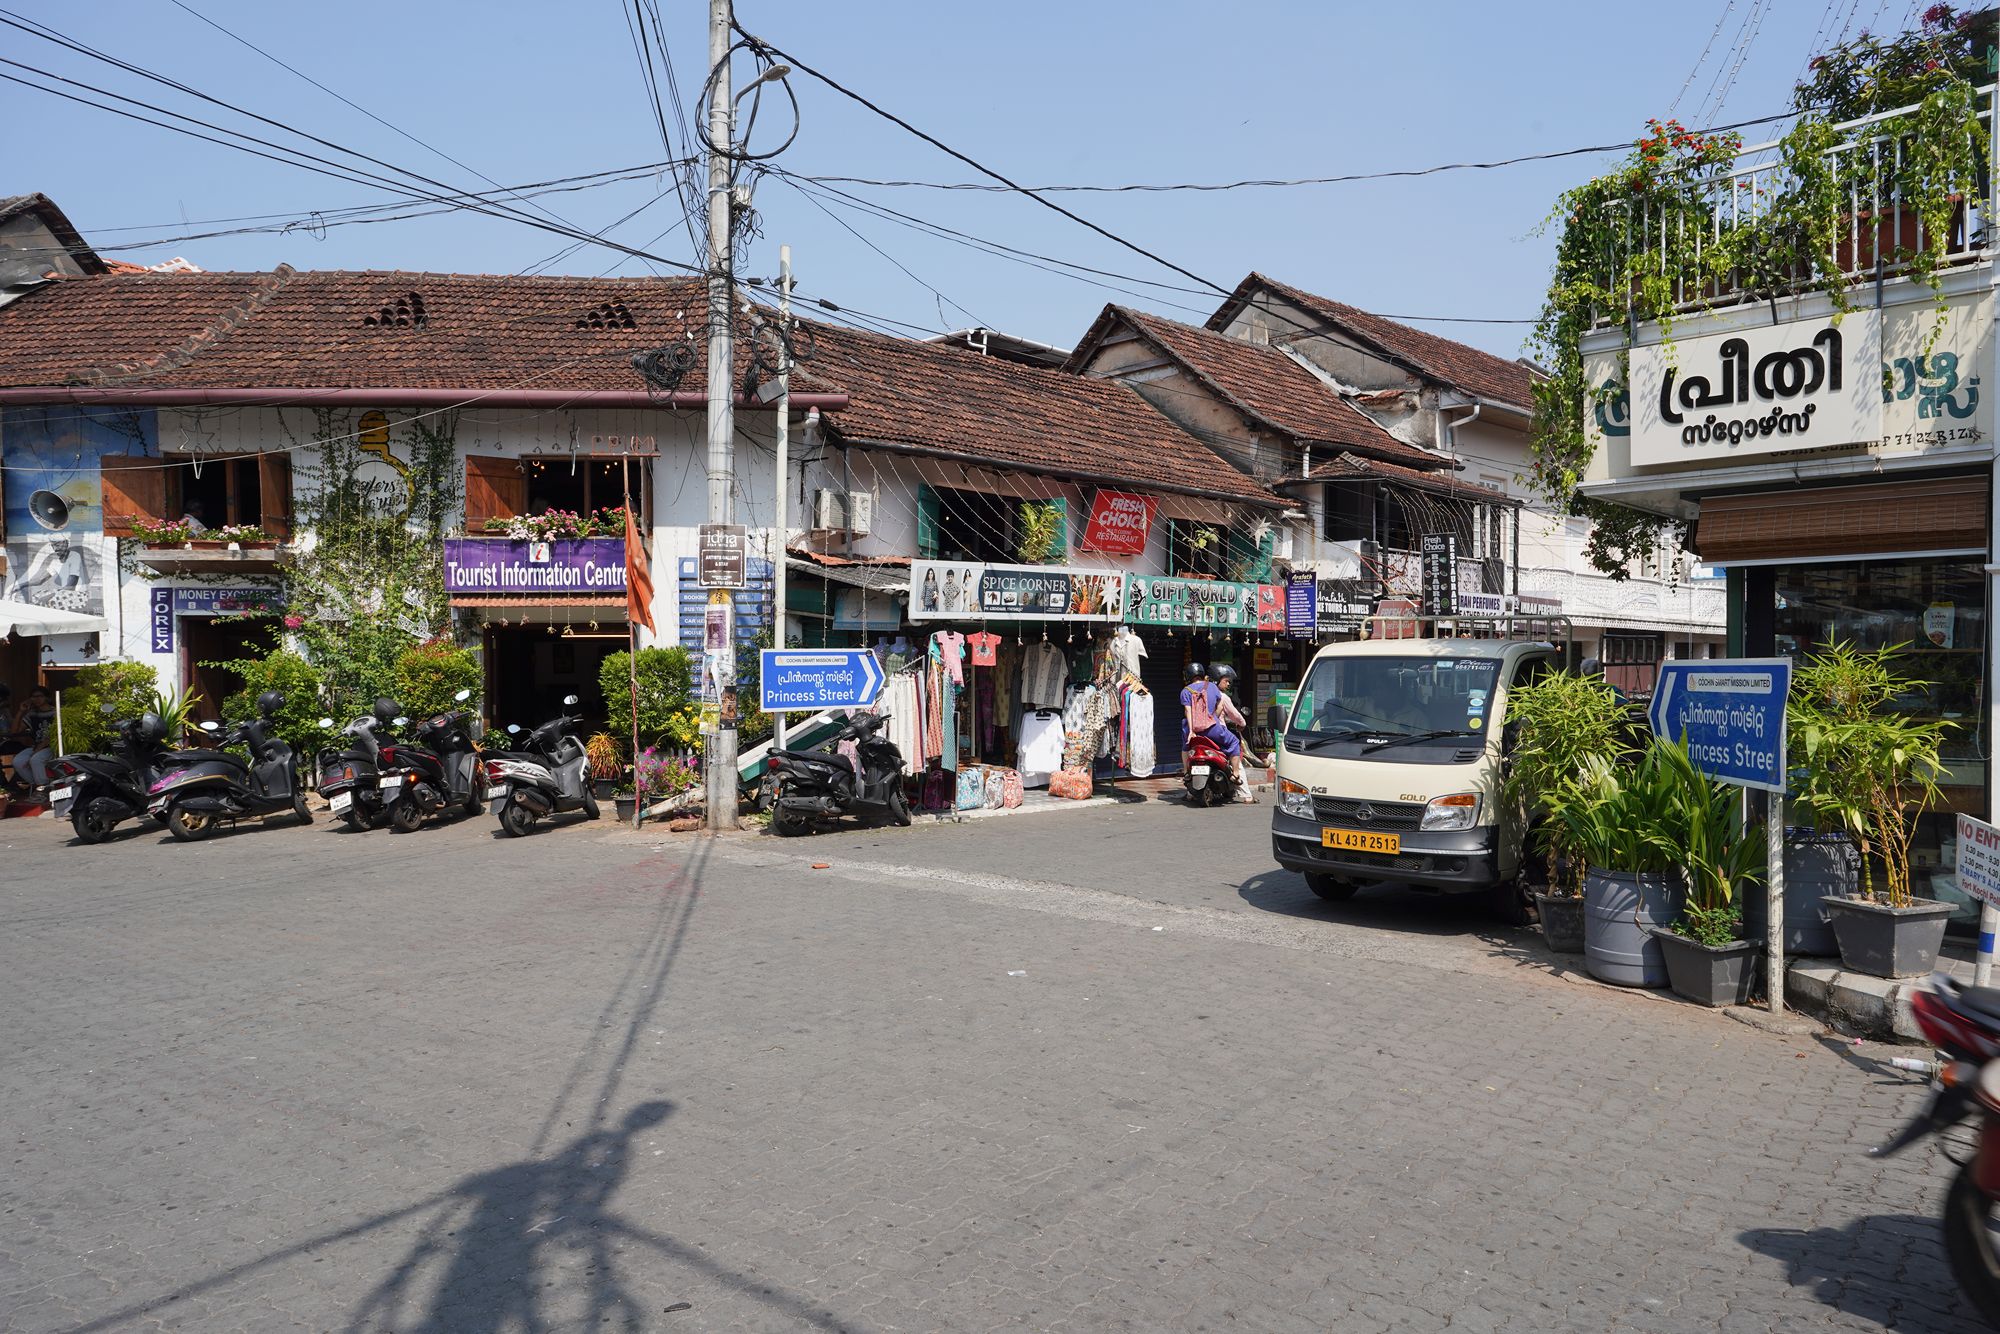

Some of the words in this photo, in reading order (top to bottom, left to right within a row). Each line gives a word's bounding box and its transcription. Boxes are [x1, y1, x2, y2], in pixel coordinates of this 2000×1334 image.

[1660, 328, 1843, 423] പ്രീതി
[1110, 498, 1146, 513] FRESH
[1098, 510, 1146, 530] CHOICE
[1095, 531, 1140, 543] RESTAURANT
[1424, 536, 1442, 545] Fresh
[1424, 543, 1446, 551] Choice
[448, 561, 498, 587] Tourist
[500, 560, 581, 586] Information
[584, 560, 627, 587] Centre
[1449, 537, 1458, 614] RESTAURANT
[983, 576, 1016, 591] SPICE
[1019, 578, 1068, 592] CORNER
[1151, 579, 1186, 603] GIFT
[178, 590, 217, 600] MONEY
[1473, 596, 1501, 611] PERFUMES
[154, 591, 169, 650] FOREX
[1697, 677, 1714, 687] COCHIN
[1714, 677, 1730, 687] SMART
[1730, 678, 1750, 688] MISSION
[1750, 678, 1770, 688] LIMITED
[767, 690, 815, 703] Princess
[819, 688, 854, 700] Street
[1687, 738, 1730, 765] rincess
[1311, 786, 1328, 794] ACE
[1400, 793, 1427, 801] GOLD
[1959, 819, 1973, 839] NO
[1330, 832, 1342, 845] KL
[1345, 834, 1358, 847] 43
[1360, 835, 1367, 848] R
[1369, 836, 1397, 851] 2513
